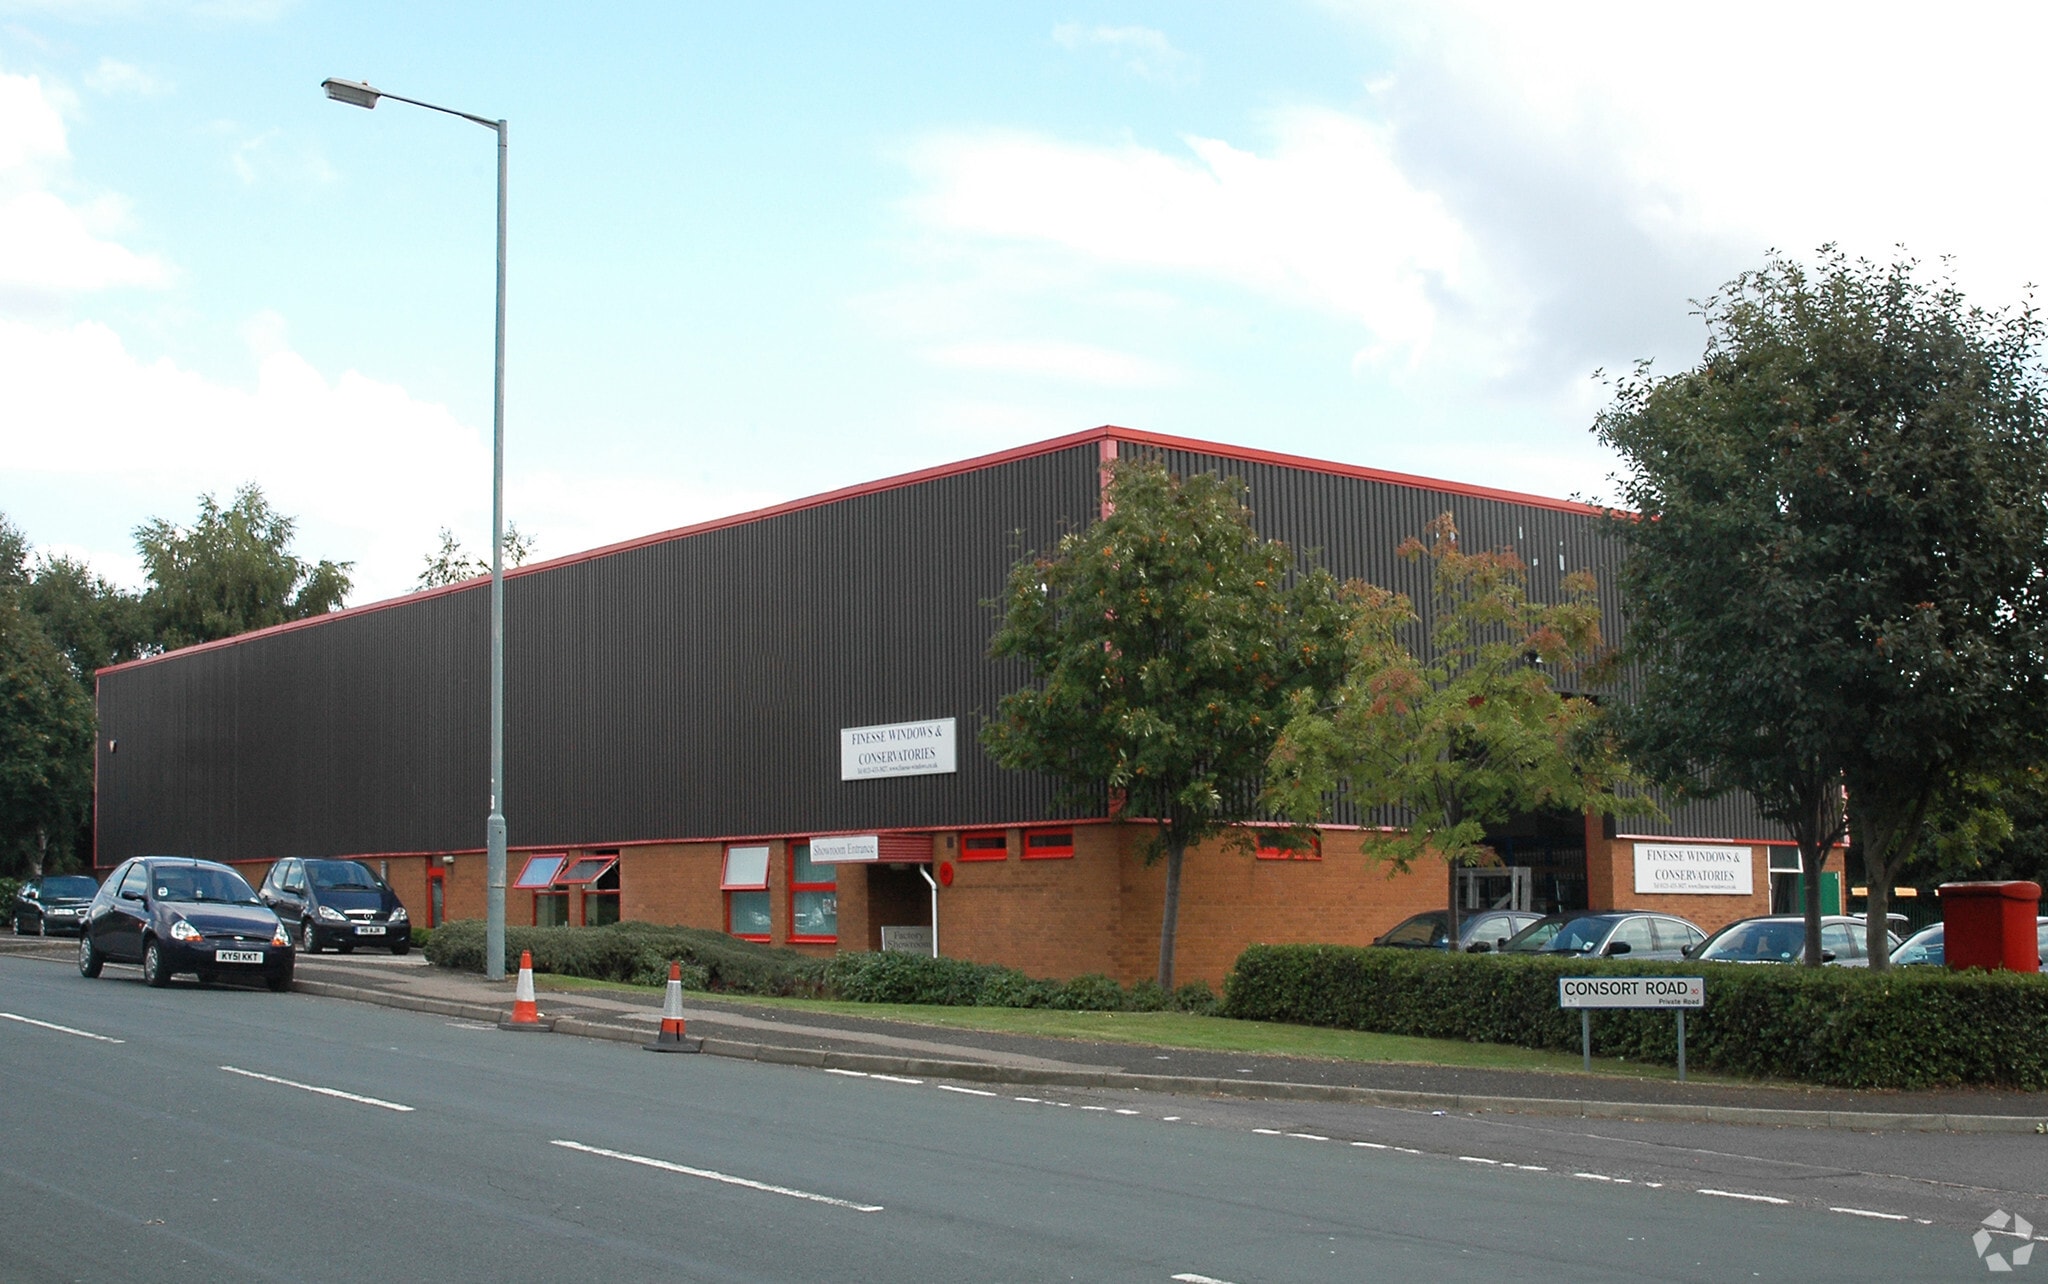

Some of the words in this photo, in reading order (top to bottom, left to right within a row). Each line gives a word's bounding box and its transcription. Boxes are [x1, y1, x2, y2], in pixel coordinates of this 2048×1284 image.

[851, 730, 886, 745] FINESSE
[888, 725, 934, 741] WINDOWS
[934, 725, 942, 737] &
[858, 747, 936, 765] CONSERVATORIES
[813, 845, 846, 856] Showroom
[847, 843, 874, 855] Entrance
[1647, 849, 1684, 861] FINESSE
[1686, 850, 1732, 862] WINDOWS
[1733, 852, 1741, 863] &
[1655, 869, 1735, 881] CONSERVATORIES
[894, 931, 923, 940] Factory
[221, 952, 241, 960] KY51
[242, 953, 258, 961] KKT
[1564, 981, 1639, 996] CONSORT
[1646, 981, 1688, 995] ROAD
